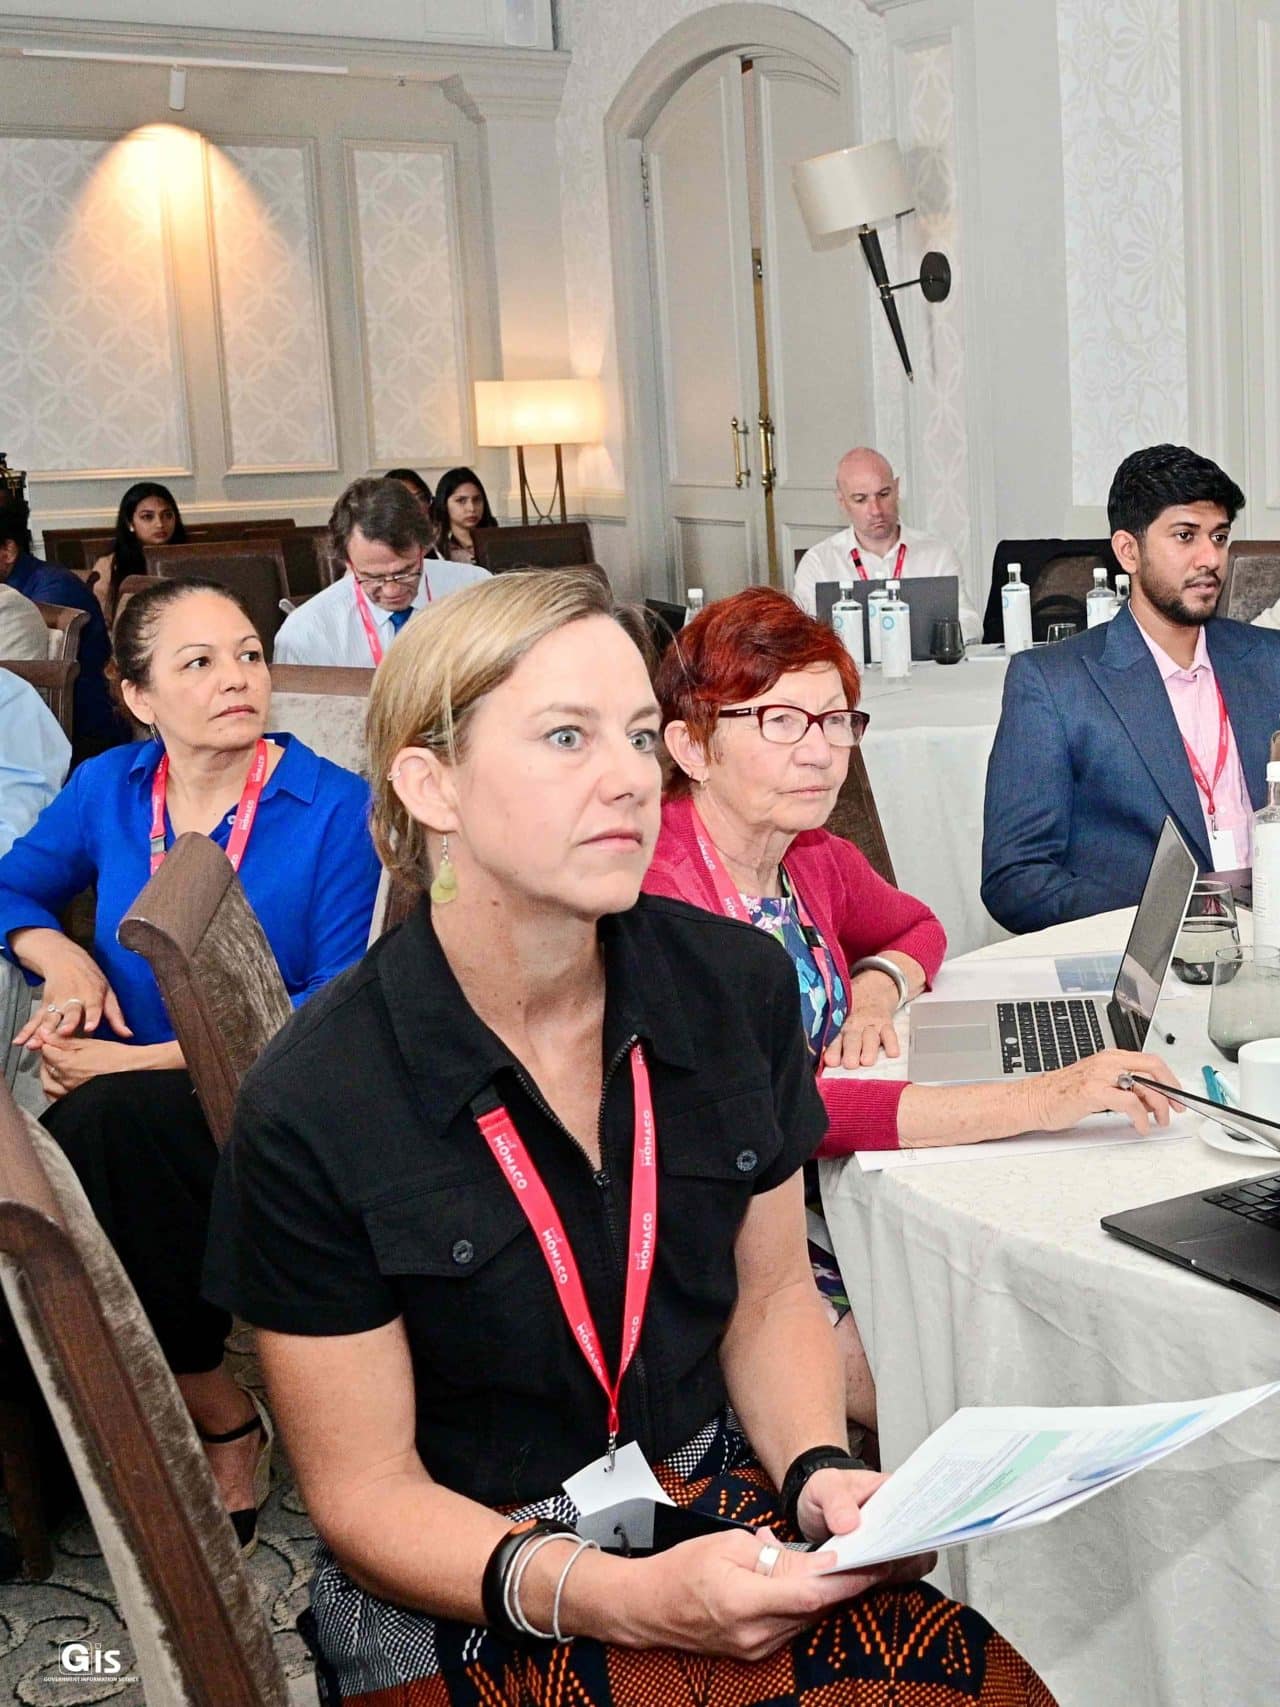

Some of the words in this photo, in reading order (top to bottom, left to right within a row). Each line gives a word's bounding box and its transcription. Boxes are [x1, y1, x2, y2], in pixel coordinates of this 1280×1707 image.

[493, 1135, 528, 1190] MONACO
[644, 1109, 653, 1167] MONACO
[542, 1229, 569, 1285] MONACO
[640, 1212, 653, 1270] MONACO
